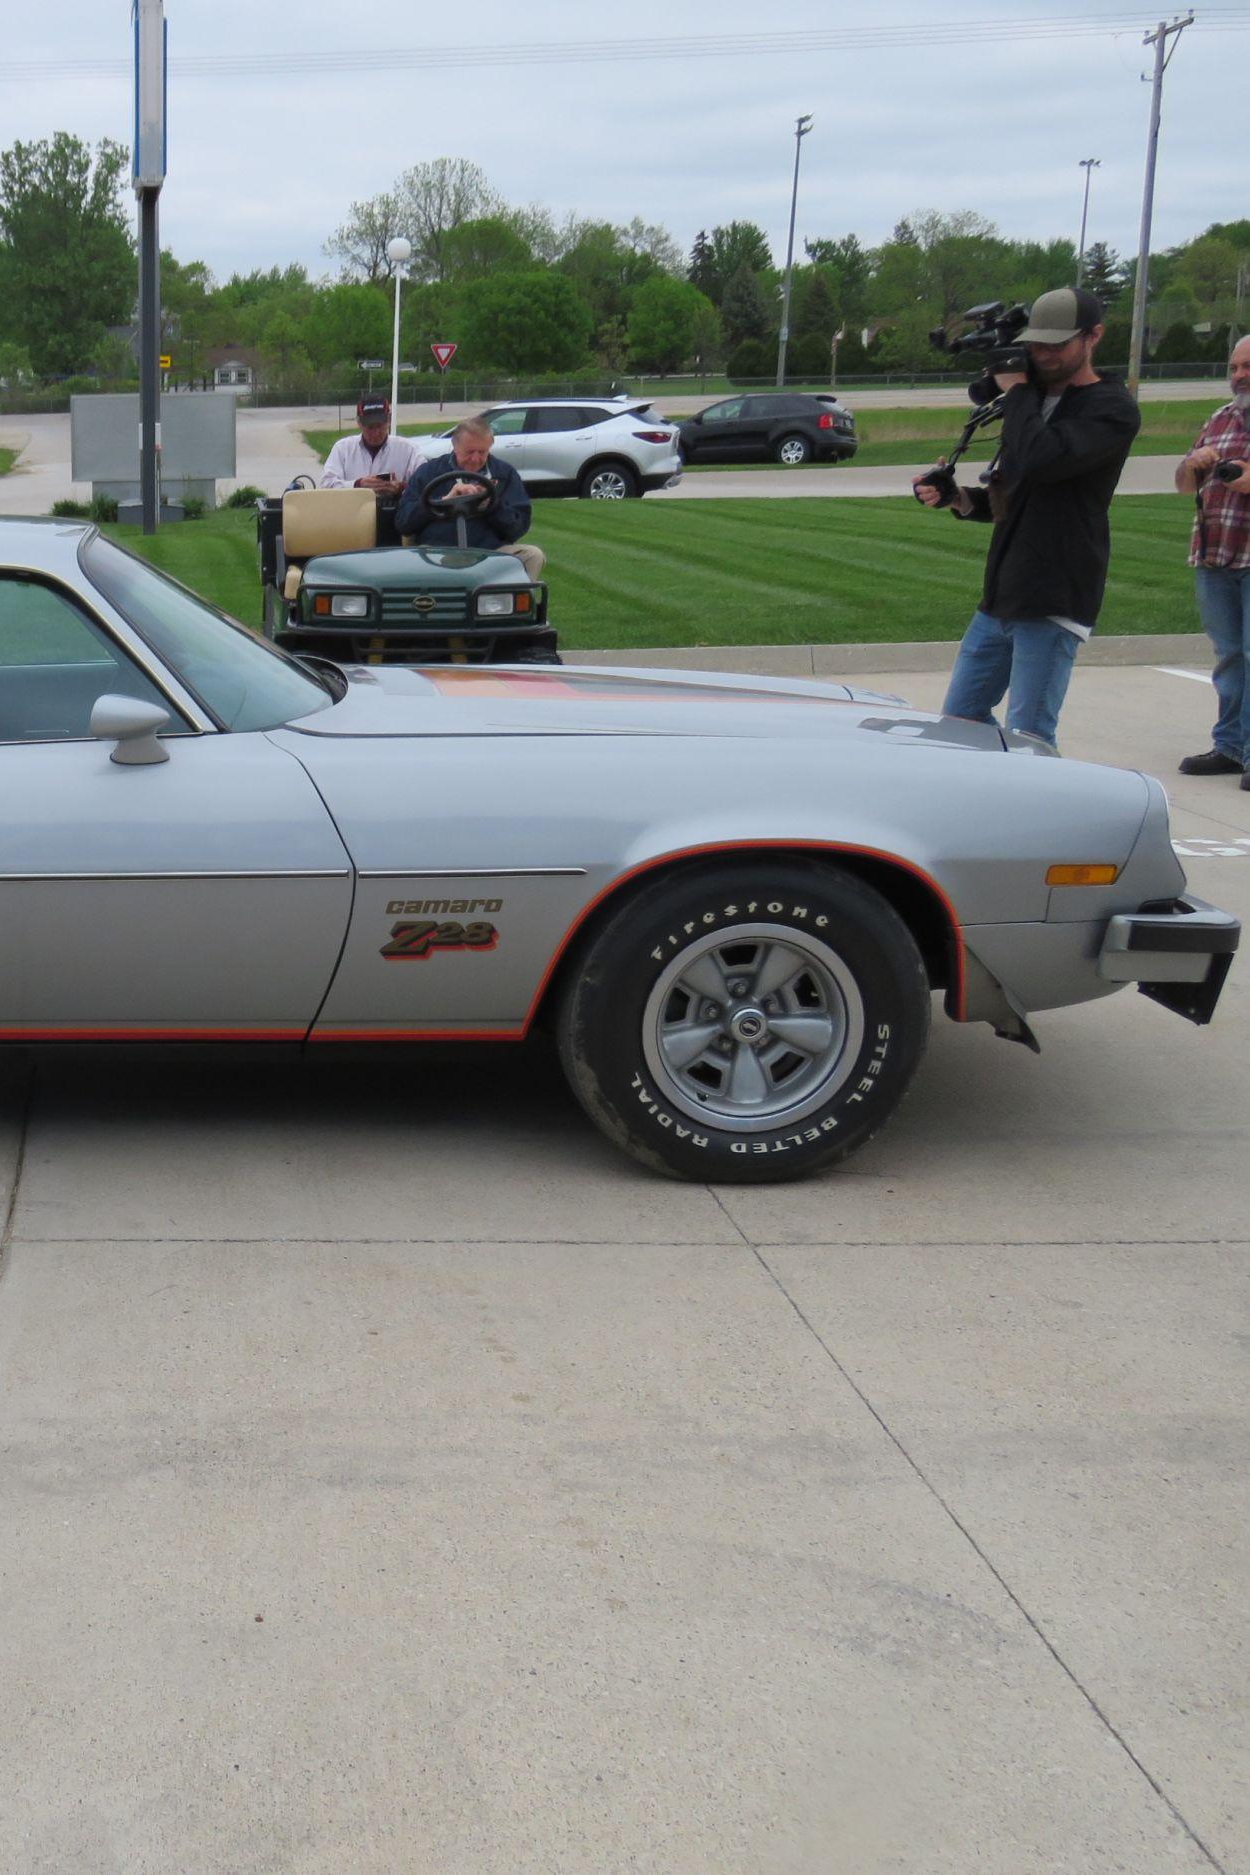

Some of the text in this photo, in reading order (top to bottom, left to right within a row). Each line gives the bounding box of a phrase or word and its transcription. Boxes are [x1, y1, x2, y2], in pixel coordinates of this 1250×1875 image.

[378, 920, 499, 960] Z28
[630, 1023, 890, 1154] STEEL BELTED RADIAL
